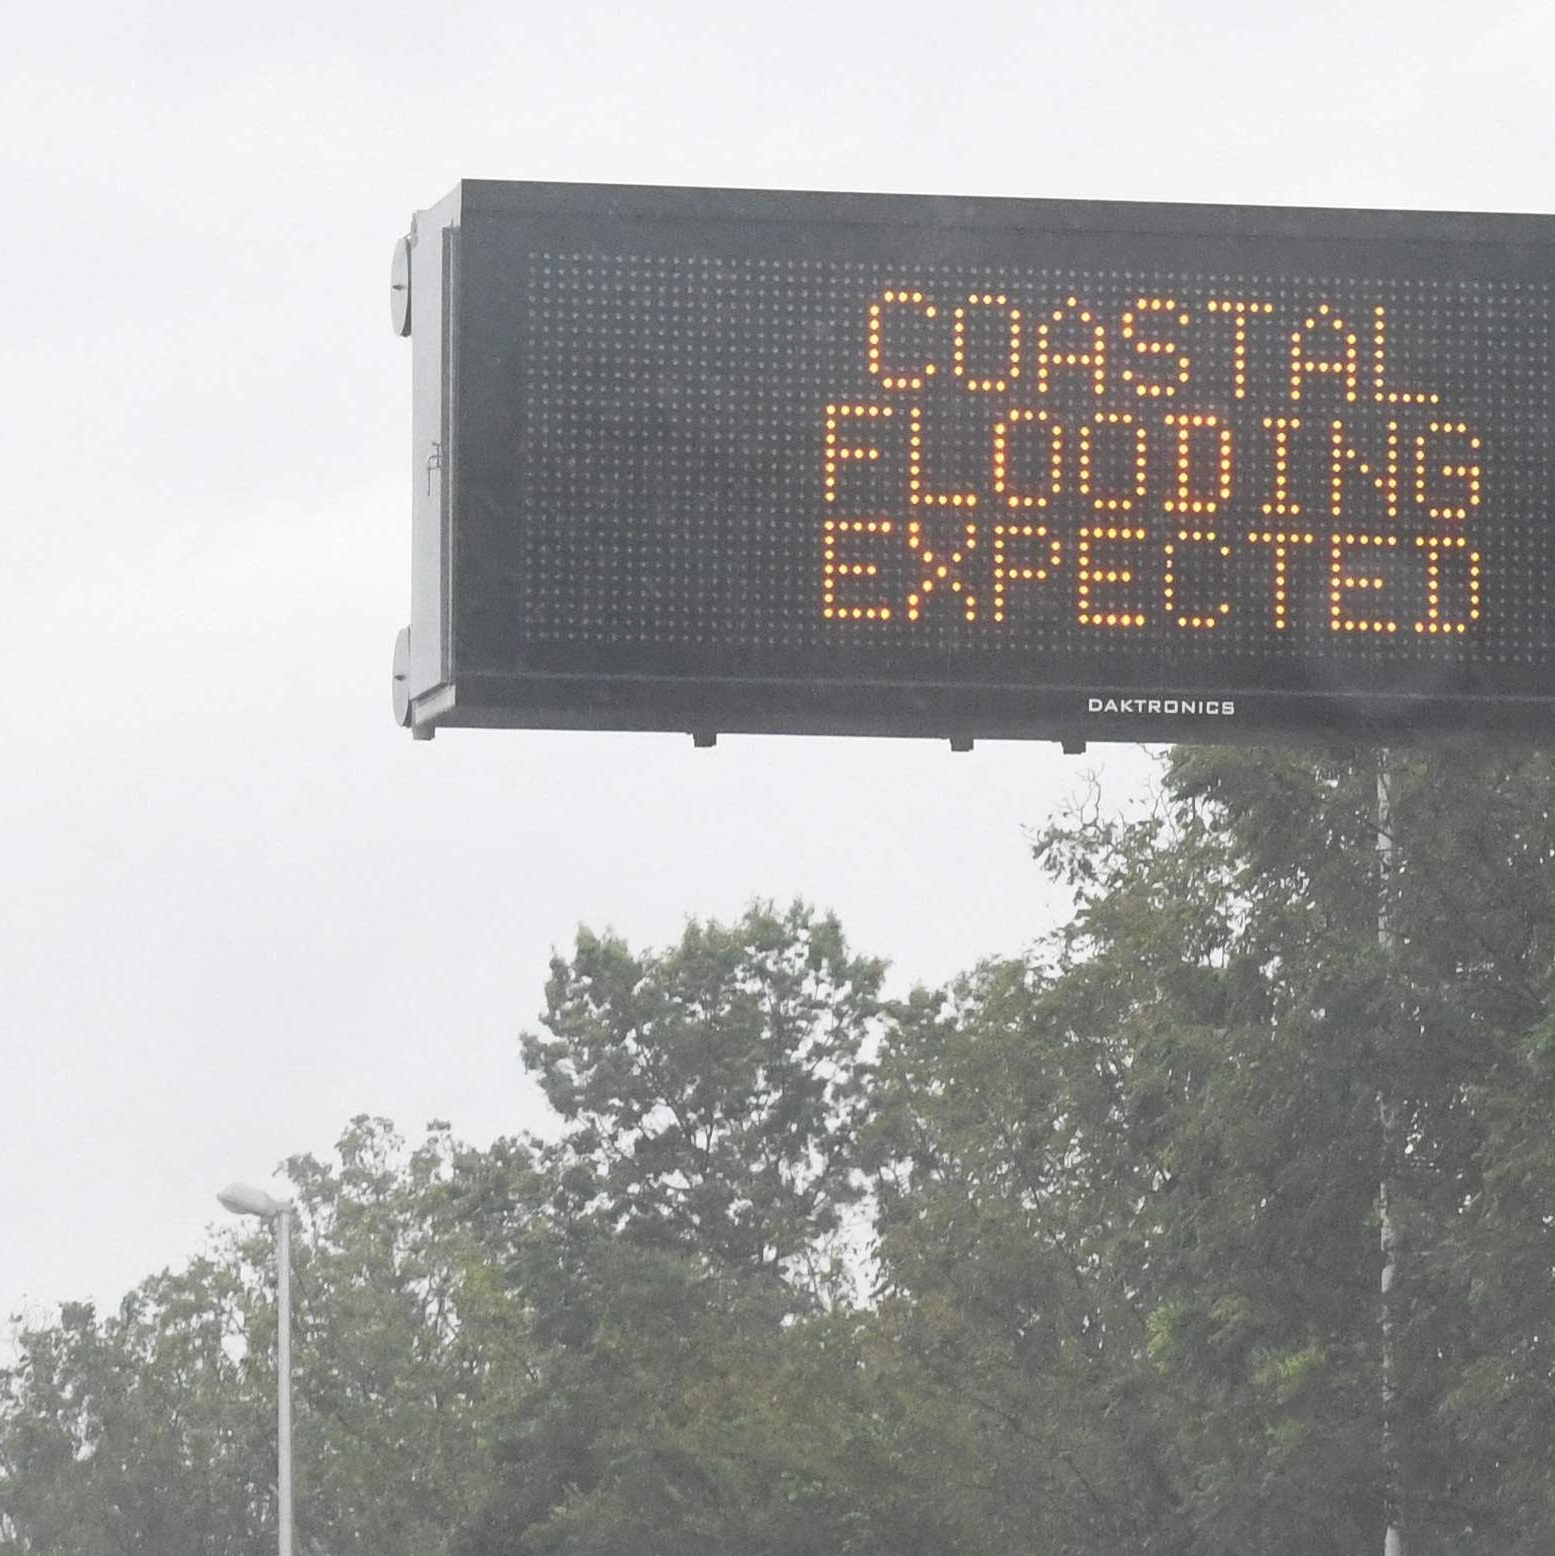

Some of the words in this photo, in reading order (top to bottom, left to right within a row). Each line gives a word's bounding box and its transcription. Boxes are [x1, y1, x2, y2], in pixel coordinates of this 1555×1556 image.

[868, 291, 1440, 404] COASTAL
[824, 404, 1481, 519] FLOODING
[823, 518, 1481, 633] EXPECTED
[1088, 698, 1235, 715] DAKTRONICS
